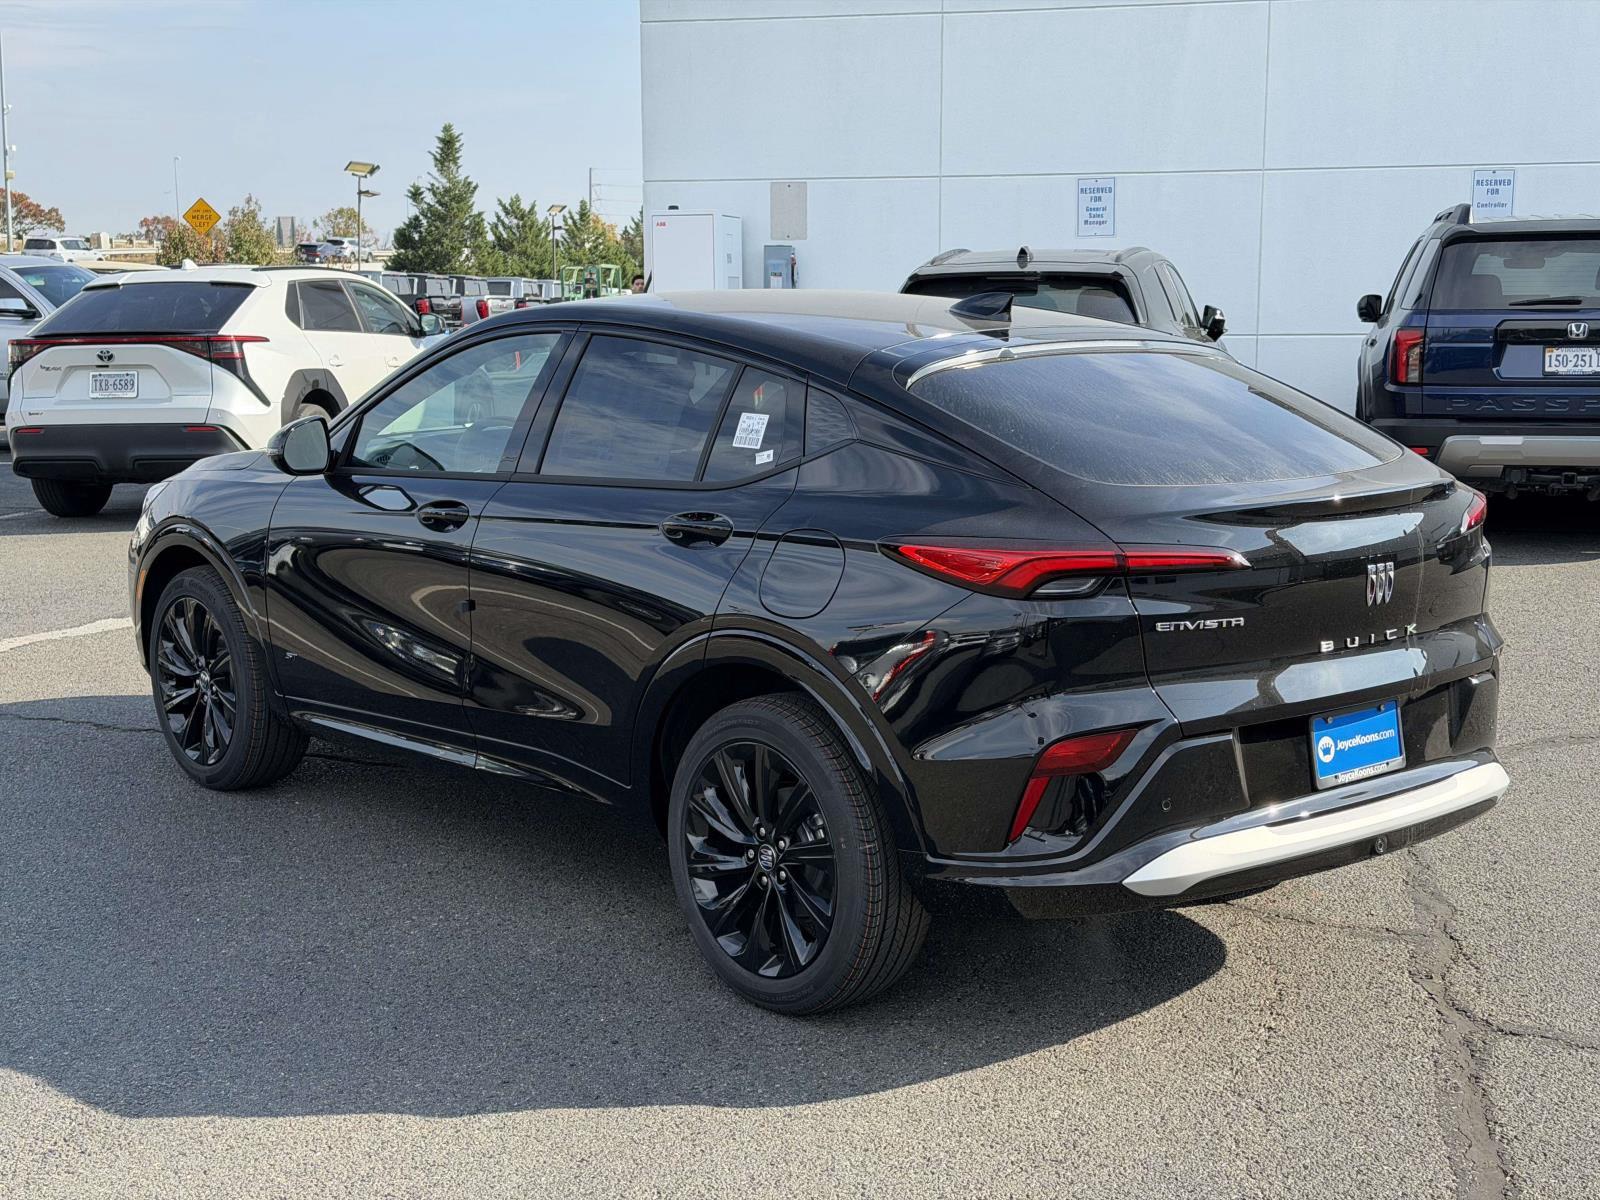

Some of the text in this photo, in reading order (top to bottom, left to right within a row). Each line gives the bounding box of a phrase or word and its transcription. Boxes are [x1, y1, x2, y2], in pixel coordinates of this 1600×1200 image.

[1476, 179, 1512, 187] RESERVED
[1486, 188, 1500, 196] FOR
[93, 378, 135, 392] TKB-6589
[1155, 616, 1245, 632] ENVISTA
[1320, 623, 1417, 653] BUICK
[1336, 727, 1395, 752] JoyceKoons.com
[1337, 763, 1388, 783] JoyceKoons.com
